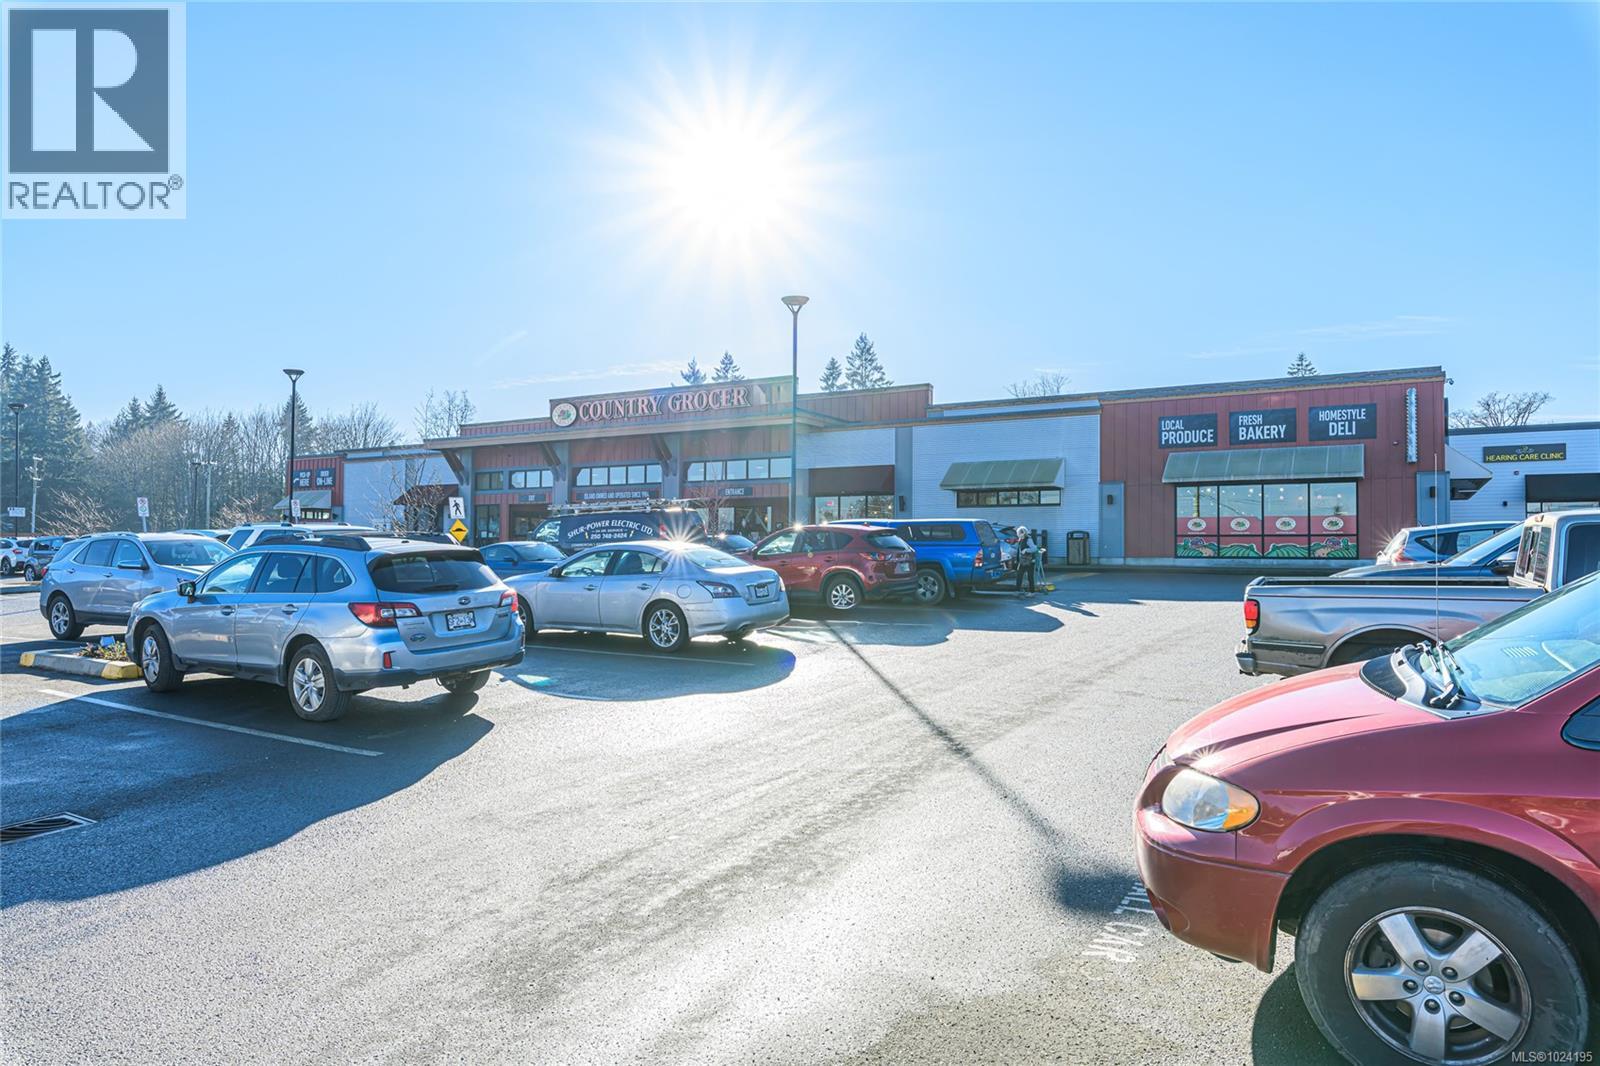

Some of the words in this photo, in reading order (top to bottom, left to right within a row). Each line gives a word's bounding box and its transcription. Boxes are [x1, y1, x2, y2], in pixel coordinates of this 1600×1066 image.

[579, 395, 663, 421] COUNTRY
[668, 387, 750, 413] GROCER
[1238, 414, 1263, 426] FRESH
[1318, 408, 1366, 422] HOMESTYLE
[1161, 420, 1184, 431] LOCAL
[1328, 421, 1356, 436] DELI
[1161, 429, 1214, 445] PRODUCE
[1238, 425, 1286, 441] BAKERY
[1486, 454, 1517, 462] HEARING
[1540, 452, 1564, 460] CLINIC
[725, 487, 745, 496] ENTRANCE
[567, 520, 610, 539] SHUR-POWER
[611, 520, 641, 530] ELECTRIC
[640, 524, 654, 536] LTD.
